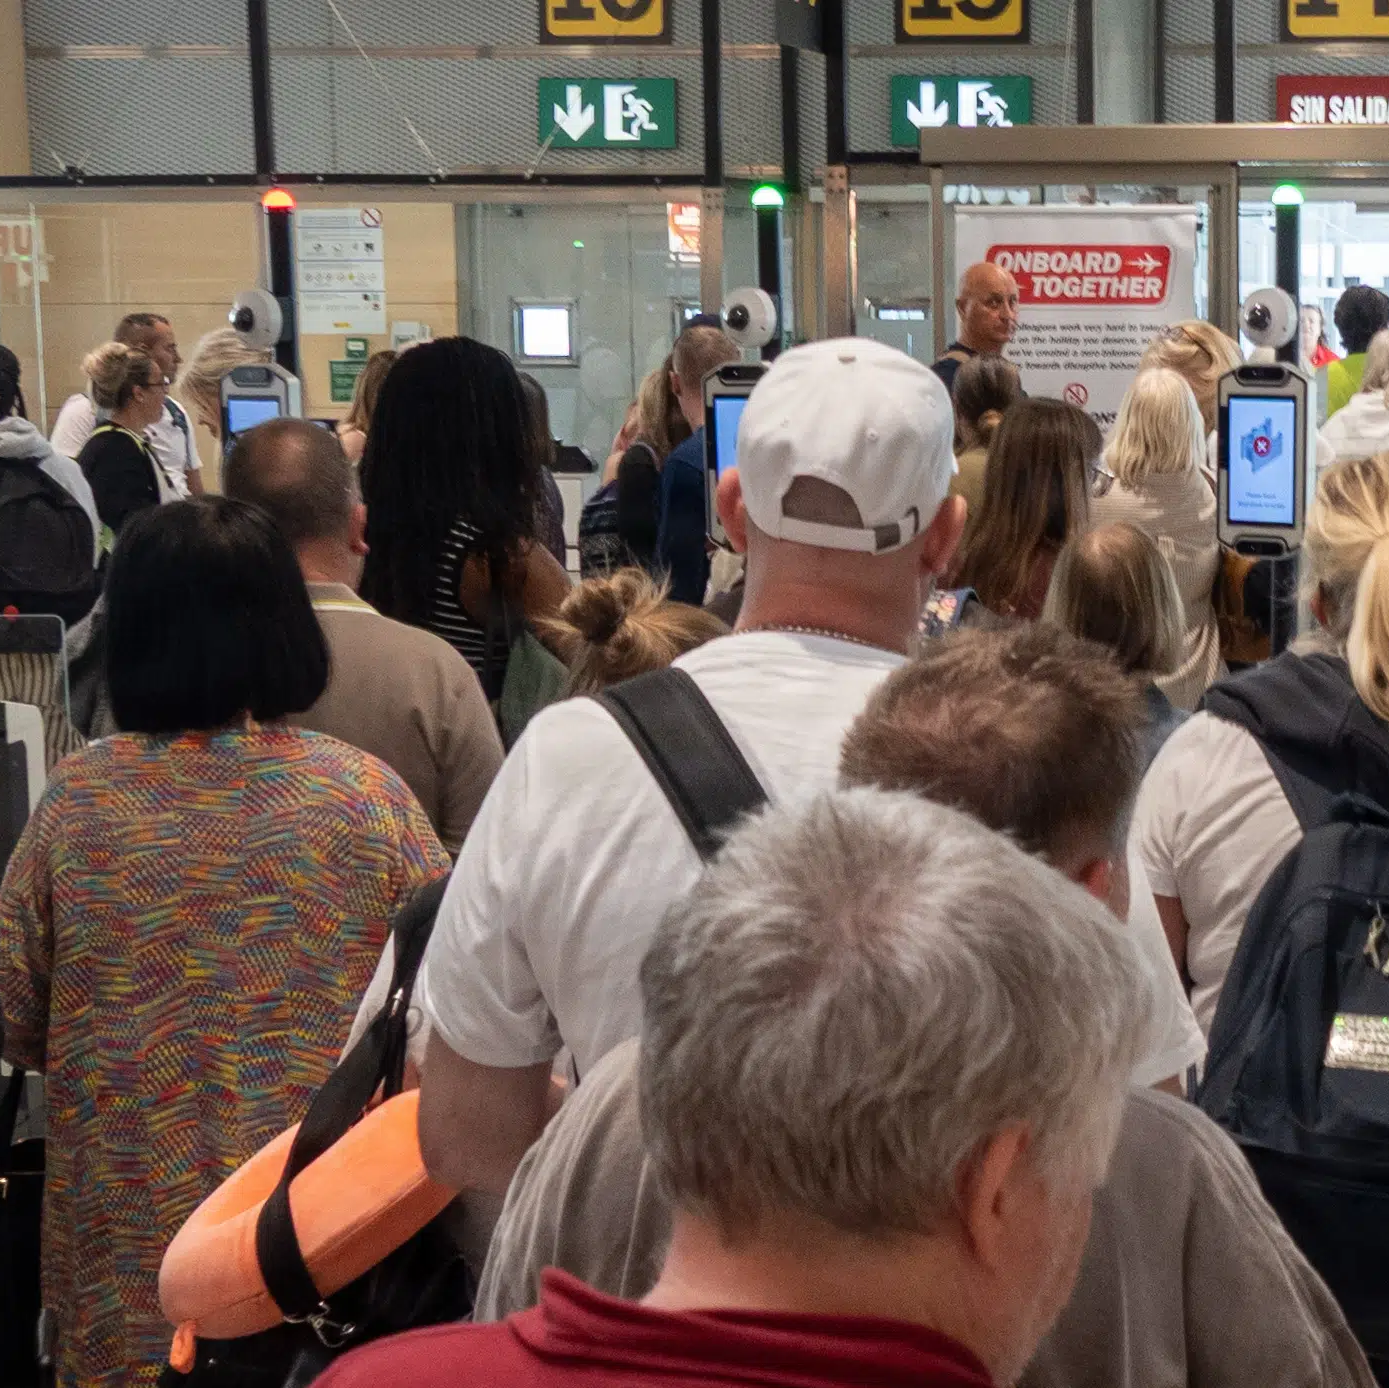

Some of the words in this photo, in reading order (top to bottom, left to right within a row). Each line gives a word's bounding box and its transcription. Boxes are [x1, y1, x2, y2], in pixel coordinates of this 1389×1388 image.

[1290, 95, 1325, 124] SIN
[993, 250, 1123, 274] ONBOARD
[1031, 275, 1163, 299] TOGETHER
